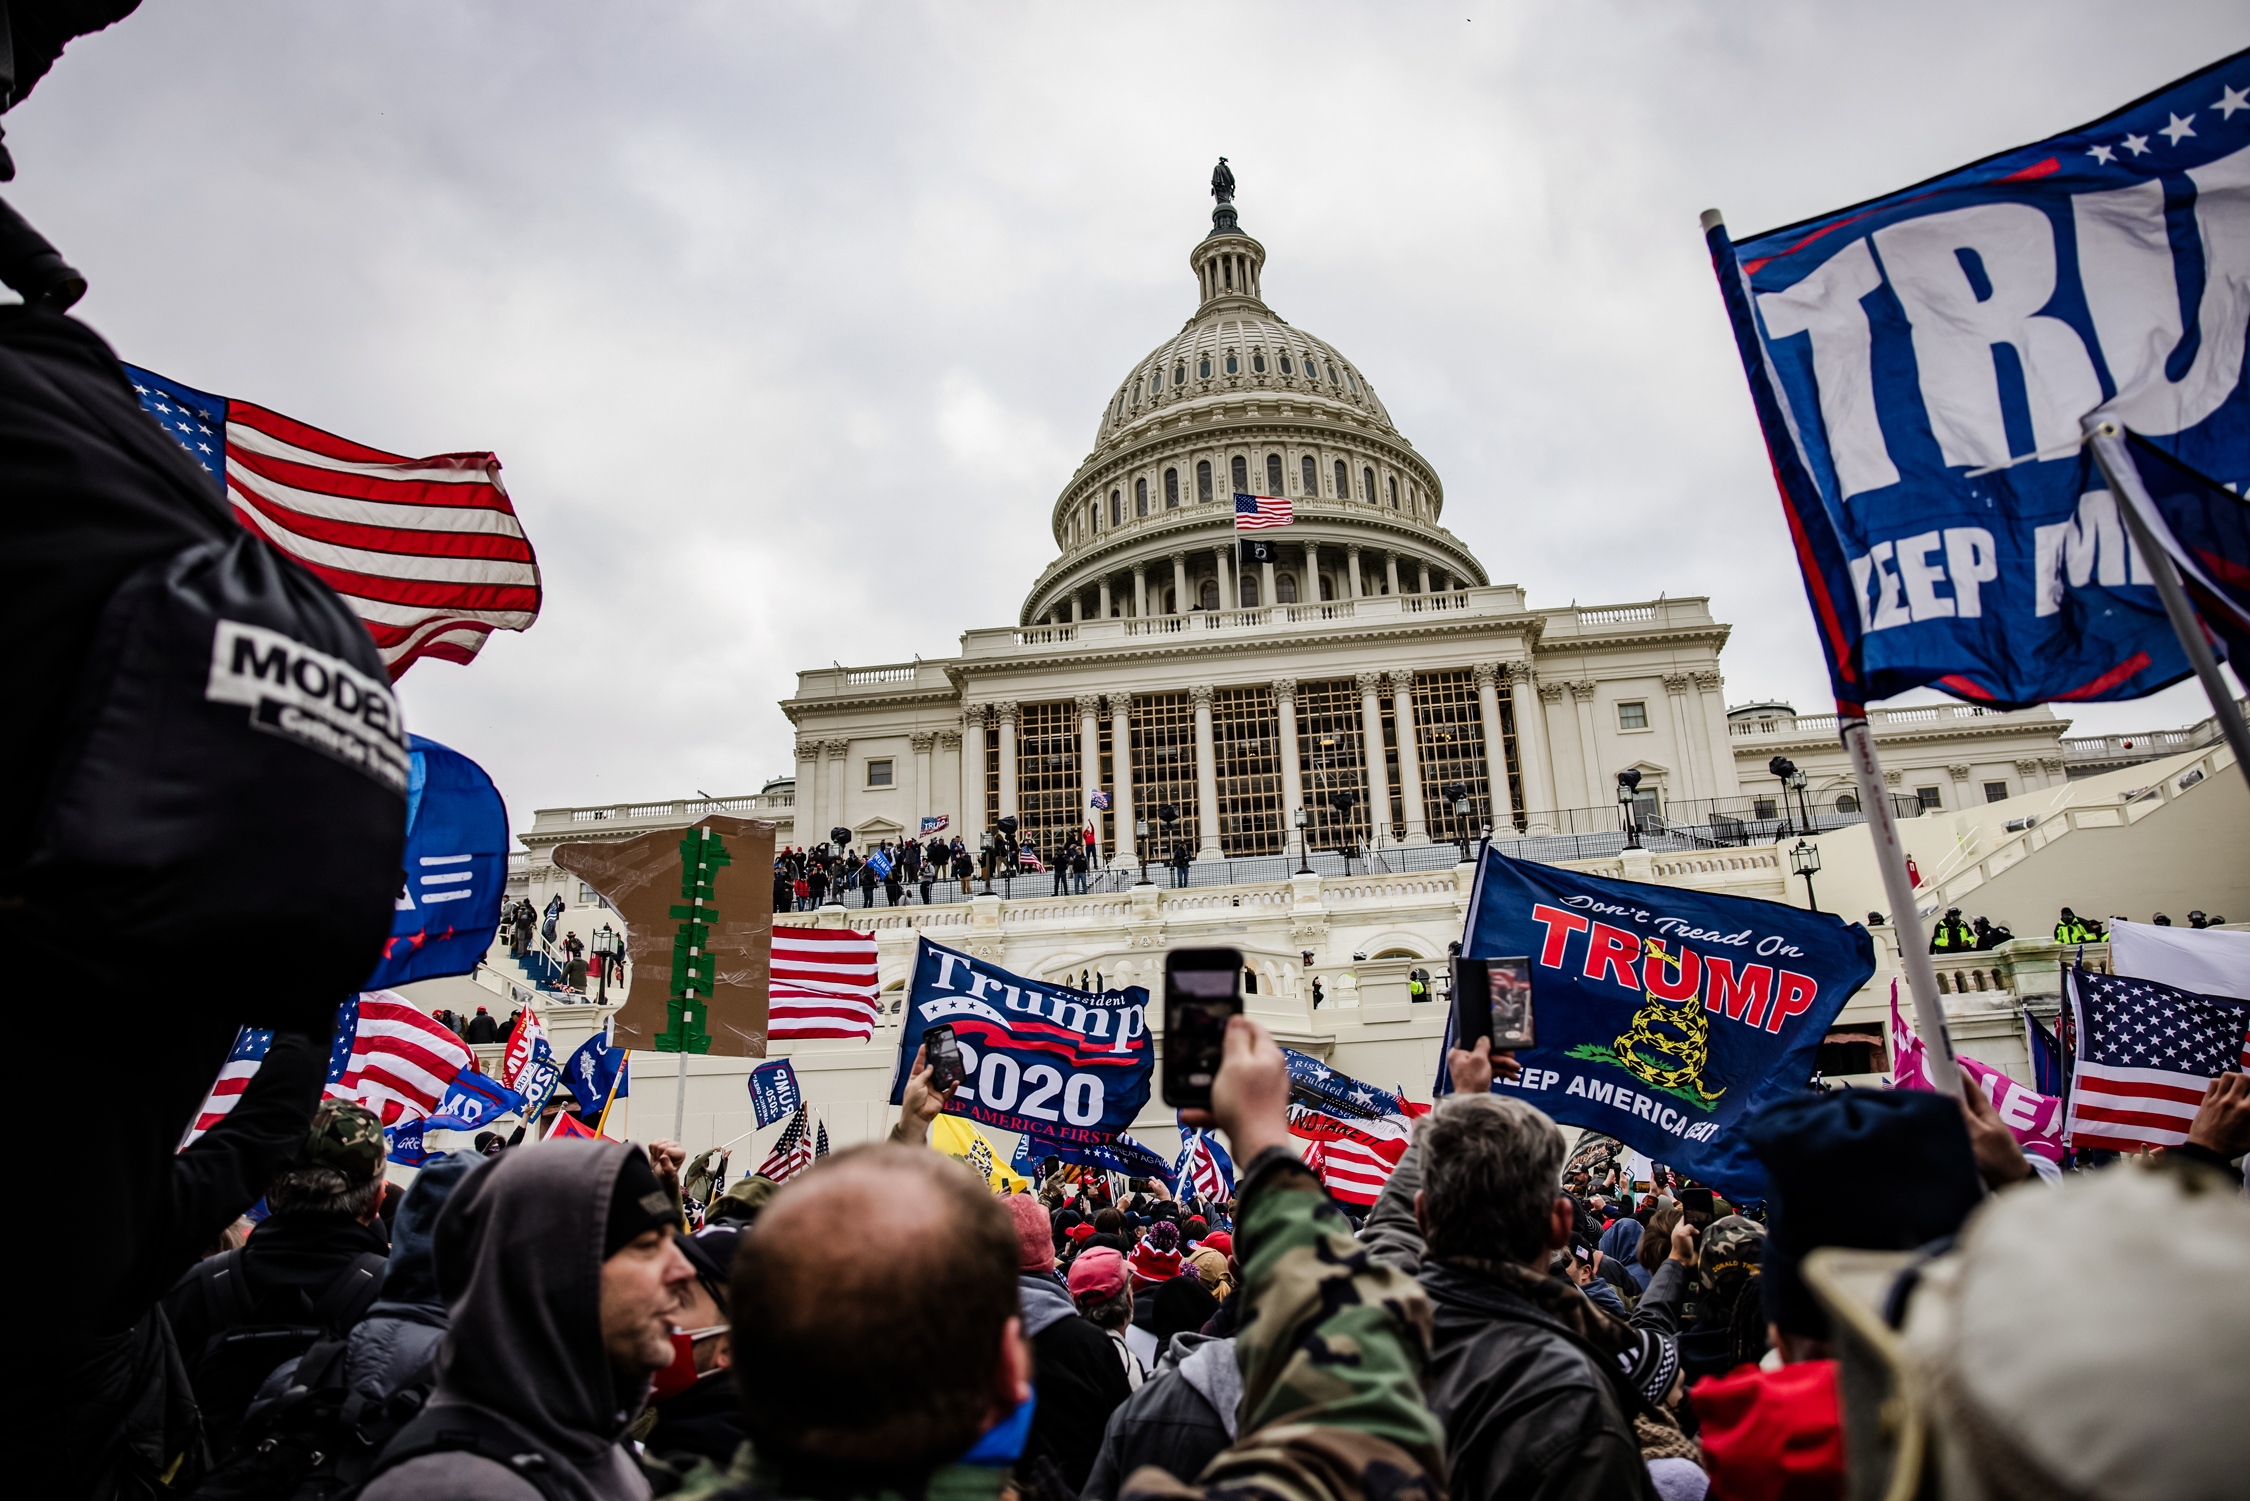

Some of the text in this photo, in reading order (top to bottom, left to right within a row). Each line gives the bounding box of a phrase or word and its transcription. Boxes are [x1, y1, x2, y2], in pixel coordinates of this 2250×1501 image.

[1559, 895, 1804, 958] Don't Tread On
[928, 947, 1144, 1053] Trump
[1532, 903, 1818, 1034] TRUMP
[944, 1099, 966, 1112] EP
[970, 1107, 1055, 1136] AMERICA
[1320, 1116, 1361, 1140] TAKE
[1361, 1135, 1385, 1147] IT
[1565, 1075, 1688, 1138] AMERICA
